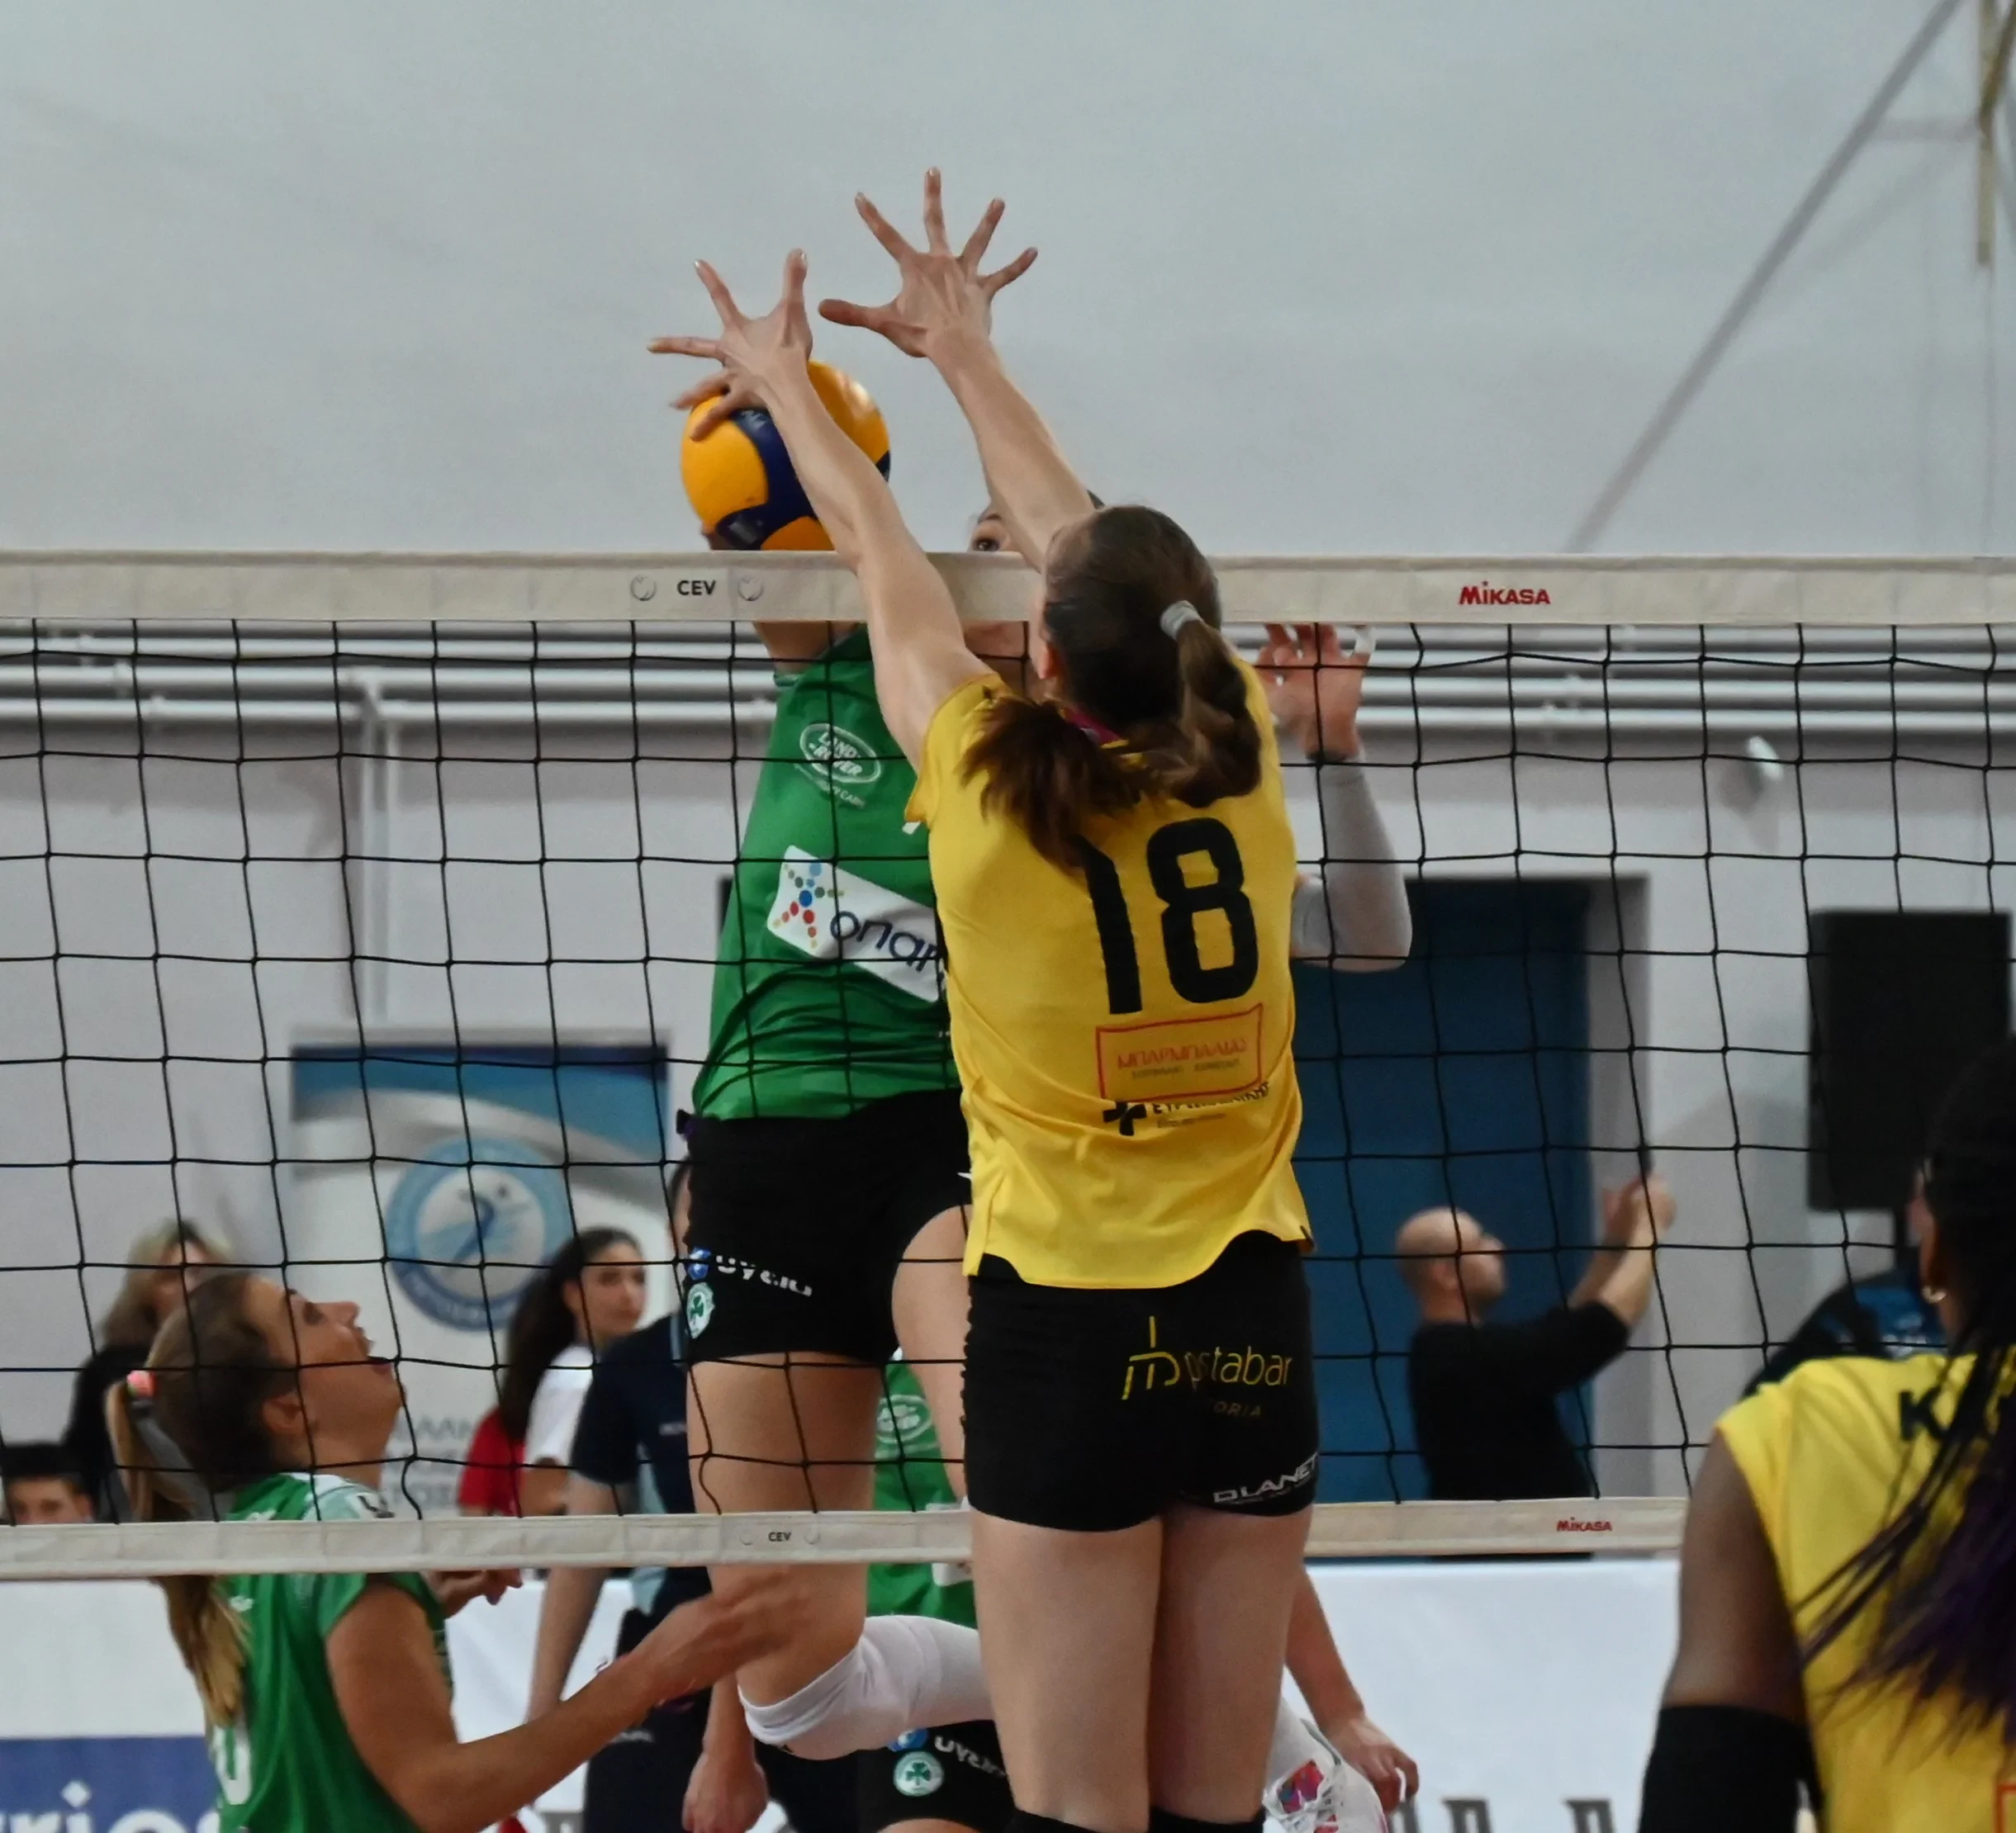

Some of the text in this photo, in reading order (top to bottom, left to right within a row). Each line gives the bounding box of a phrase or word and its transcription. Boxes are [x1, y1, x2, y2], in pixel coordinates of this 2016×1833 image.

[676, 580, 716, 596] CEV
[1072, 817, 1259, 1015] 18
[768, 1532, 792, 1542] CEV
